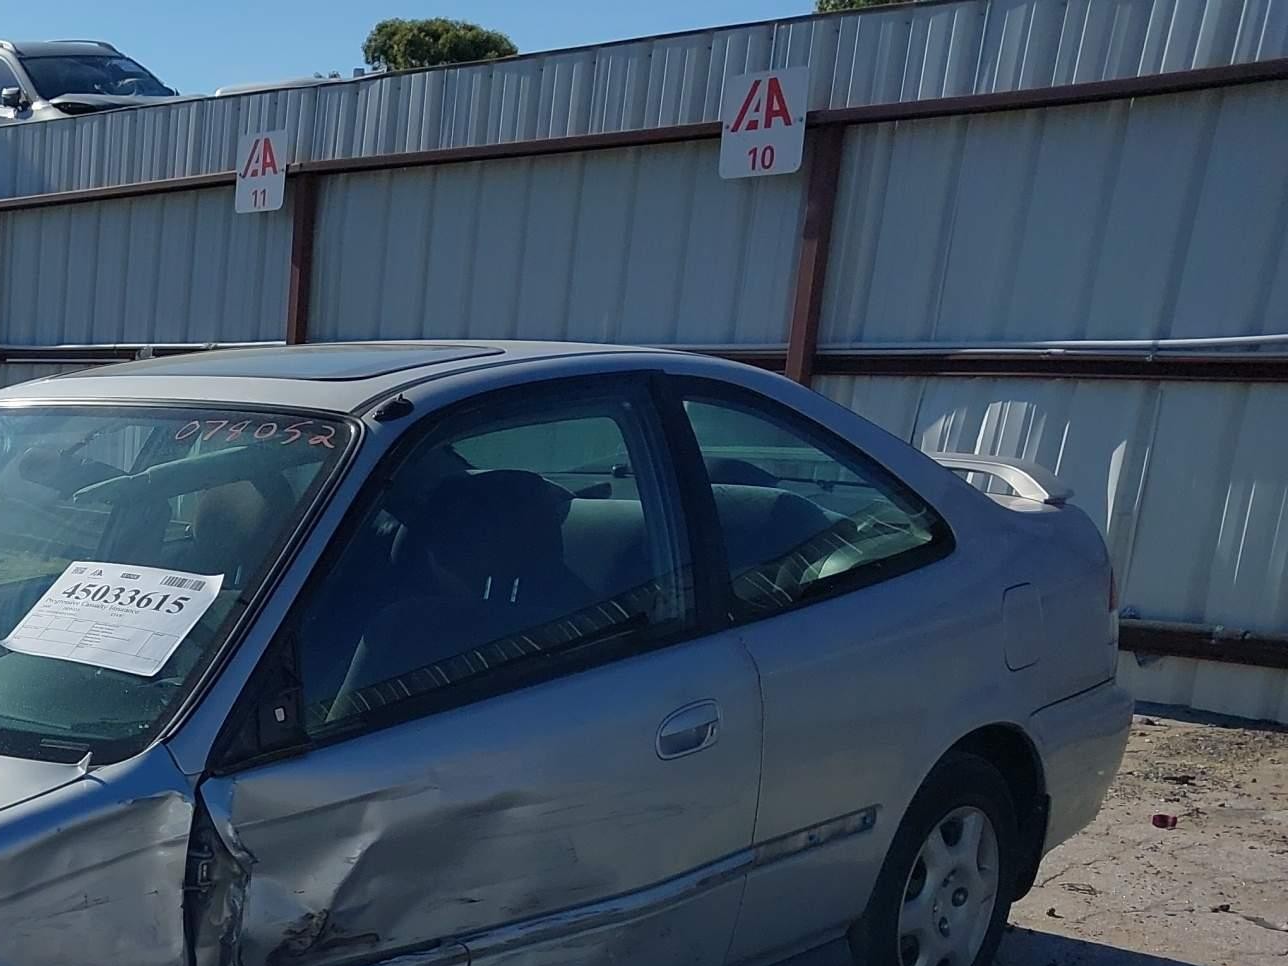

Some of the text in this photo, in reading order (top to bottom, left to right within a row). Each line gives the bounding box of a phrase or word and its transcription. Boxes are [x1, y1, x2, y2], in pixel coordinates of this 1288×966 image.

[748, 145, 775, 171] 10
[252, 189, 267, 208] 11
[62, 582, 191, 614] 45033615
